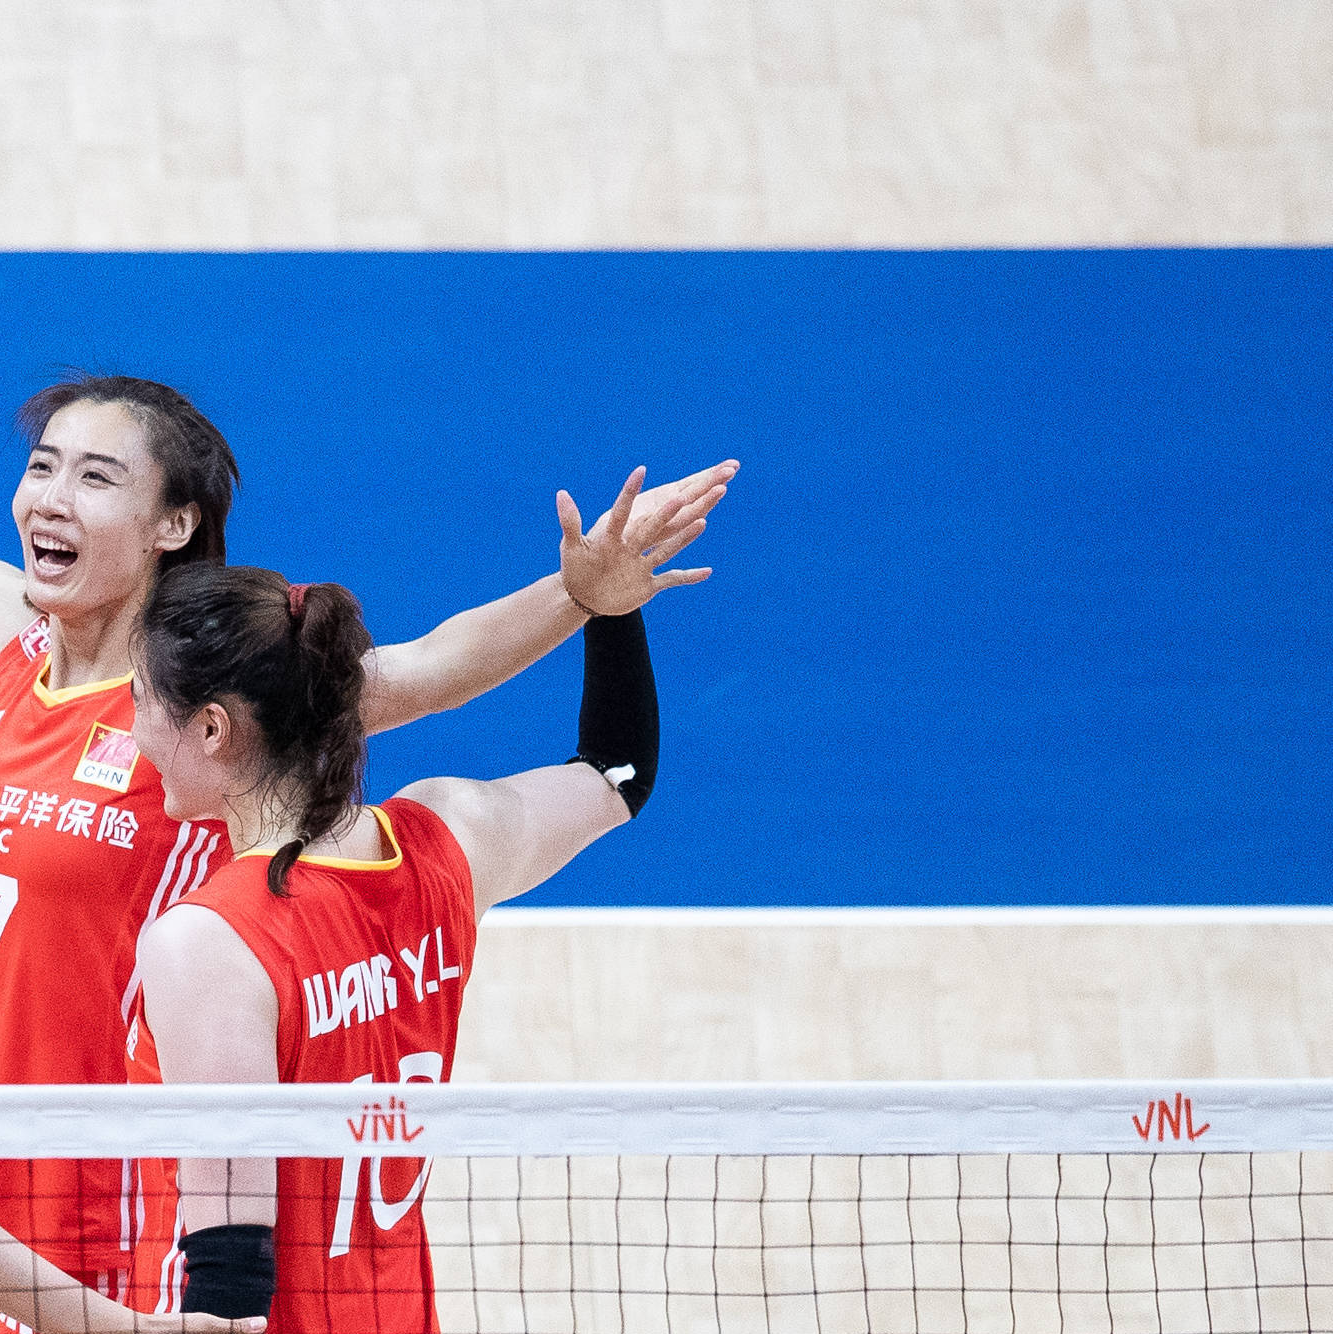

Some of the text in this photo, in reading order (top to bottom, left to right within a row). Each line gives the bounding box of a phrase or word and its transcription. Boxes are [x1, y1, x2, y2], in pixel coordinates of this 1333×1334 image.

[83, 765, 124, 785] CHN
[347, 1096, 424, 1143] VNL
[1133, 1093, 1210, 1141] VNL
